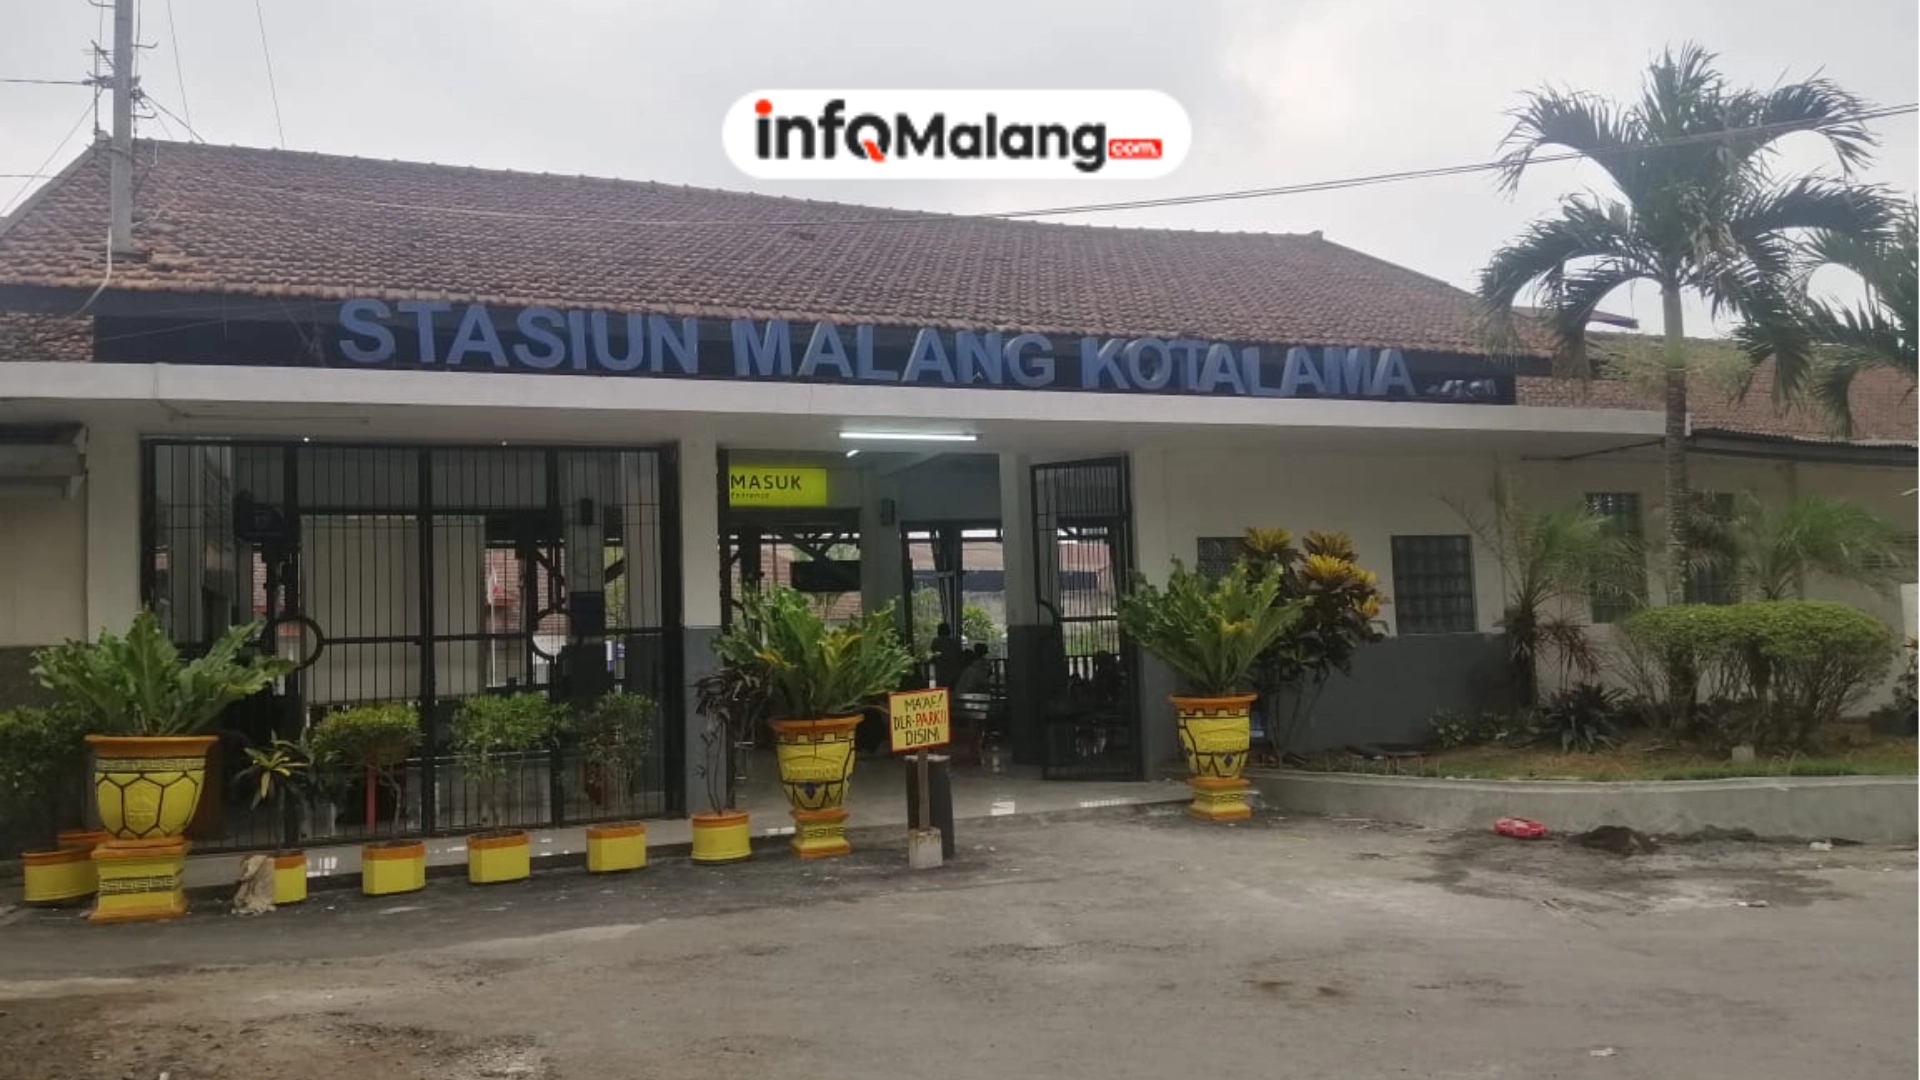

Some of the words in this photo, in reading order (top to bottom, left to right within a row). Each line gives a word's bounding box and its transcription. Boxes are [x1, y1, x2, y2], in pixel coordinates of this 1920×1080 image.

[338, 299, 700, 374] STASIUN
[731, 318, 1055, 387] MALANG
[1081, 336, 1415, 398] KOTALAMA
[730, 474, 802, 490] MASUK
[905, 726, 940, 746] DISINI
